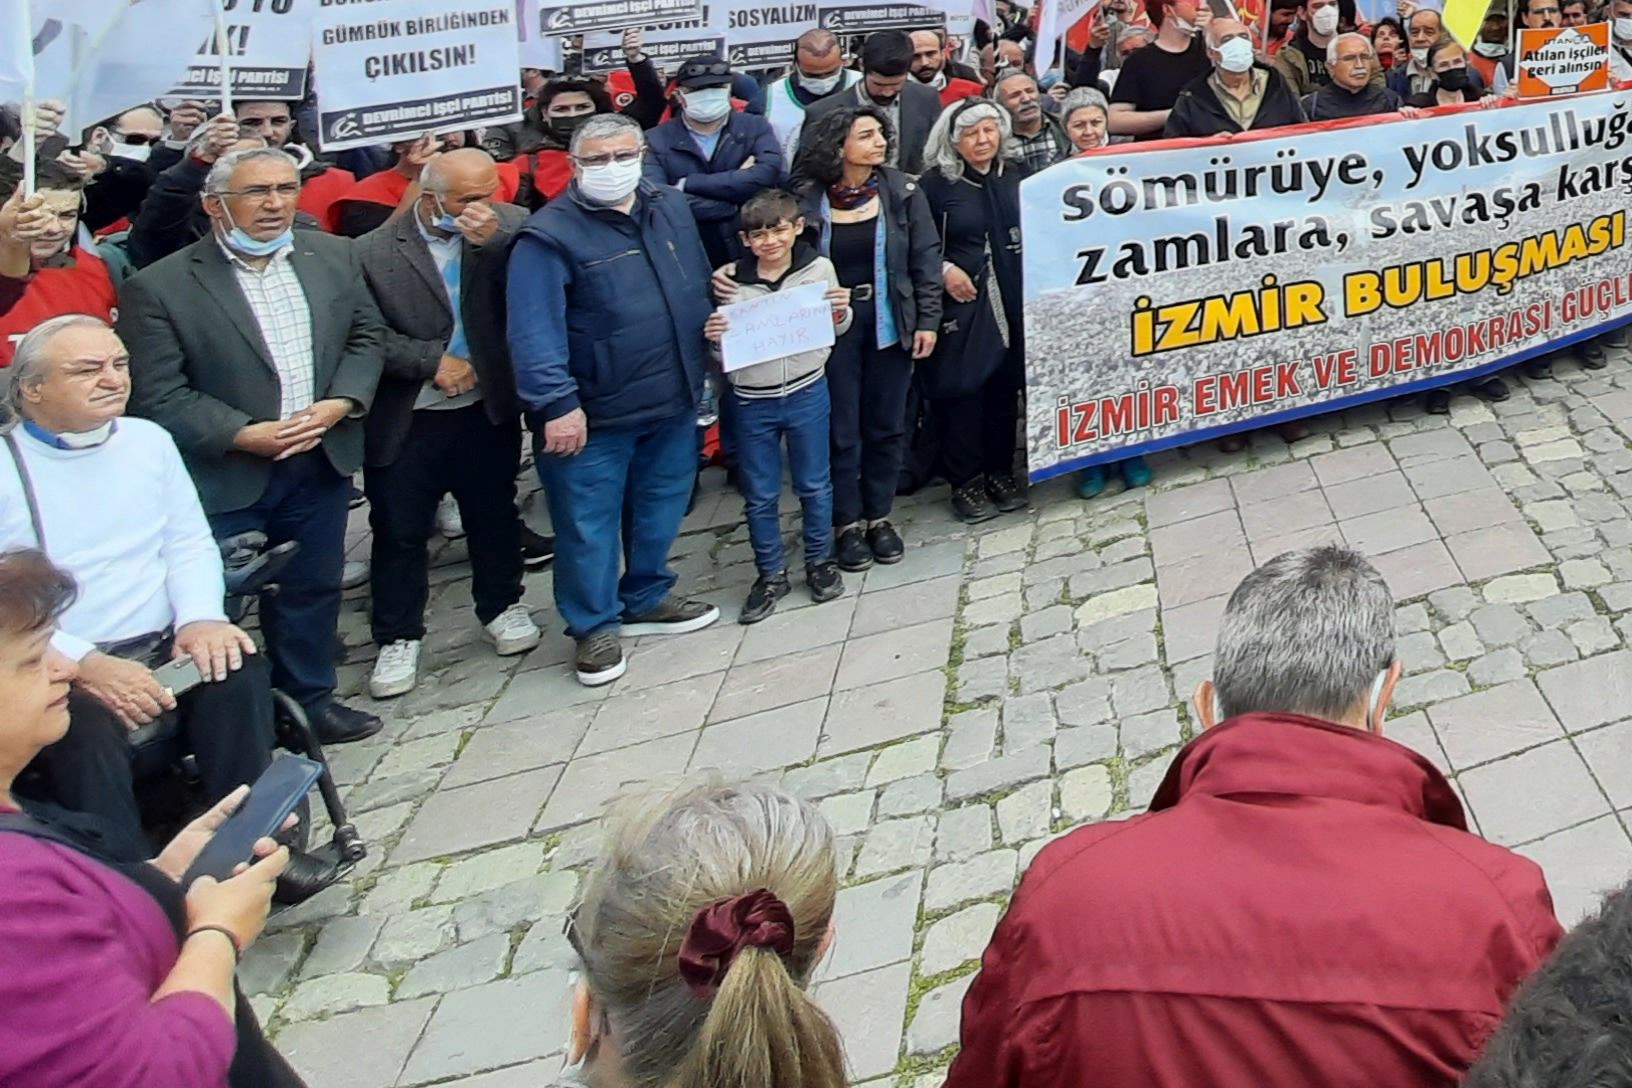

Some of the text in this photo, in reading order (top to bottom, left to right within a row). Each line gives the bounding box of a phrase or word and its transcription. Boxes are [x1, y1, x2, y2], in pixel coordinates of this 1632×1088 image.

[322, 8, 510, 46] GÜMRÜK BİRLİĞİNDEN
[364, 43, 477, 83] ÇIKILSIN!
[1523, 45, 1609, 61] Atılan işçiler
[1527, 60, 1602, 78] geri alınsın
[361, 103, 433, 125] DEVRİMCİ
[462, 89, 514, 110] PARTİSİ
[1062, 149, 1383, 222] sömürüye,
[1075, 215, 1349, 285] zamlara,
[1371, 181, 1542, 239] savaşa
[1131, 210, 1626, 357] İZMİR BULUŞMASI
[753, 327, 811, 353] HAYIR
[1056, 379, 1180, 449] İZMİR
[1193, 359, 1303, 417] EMEK
[1313, 348, 1359, 390] VE
[1368, 293, 1552, 380] DEMOKRASİ
